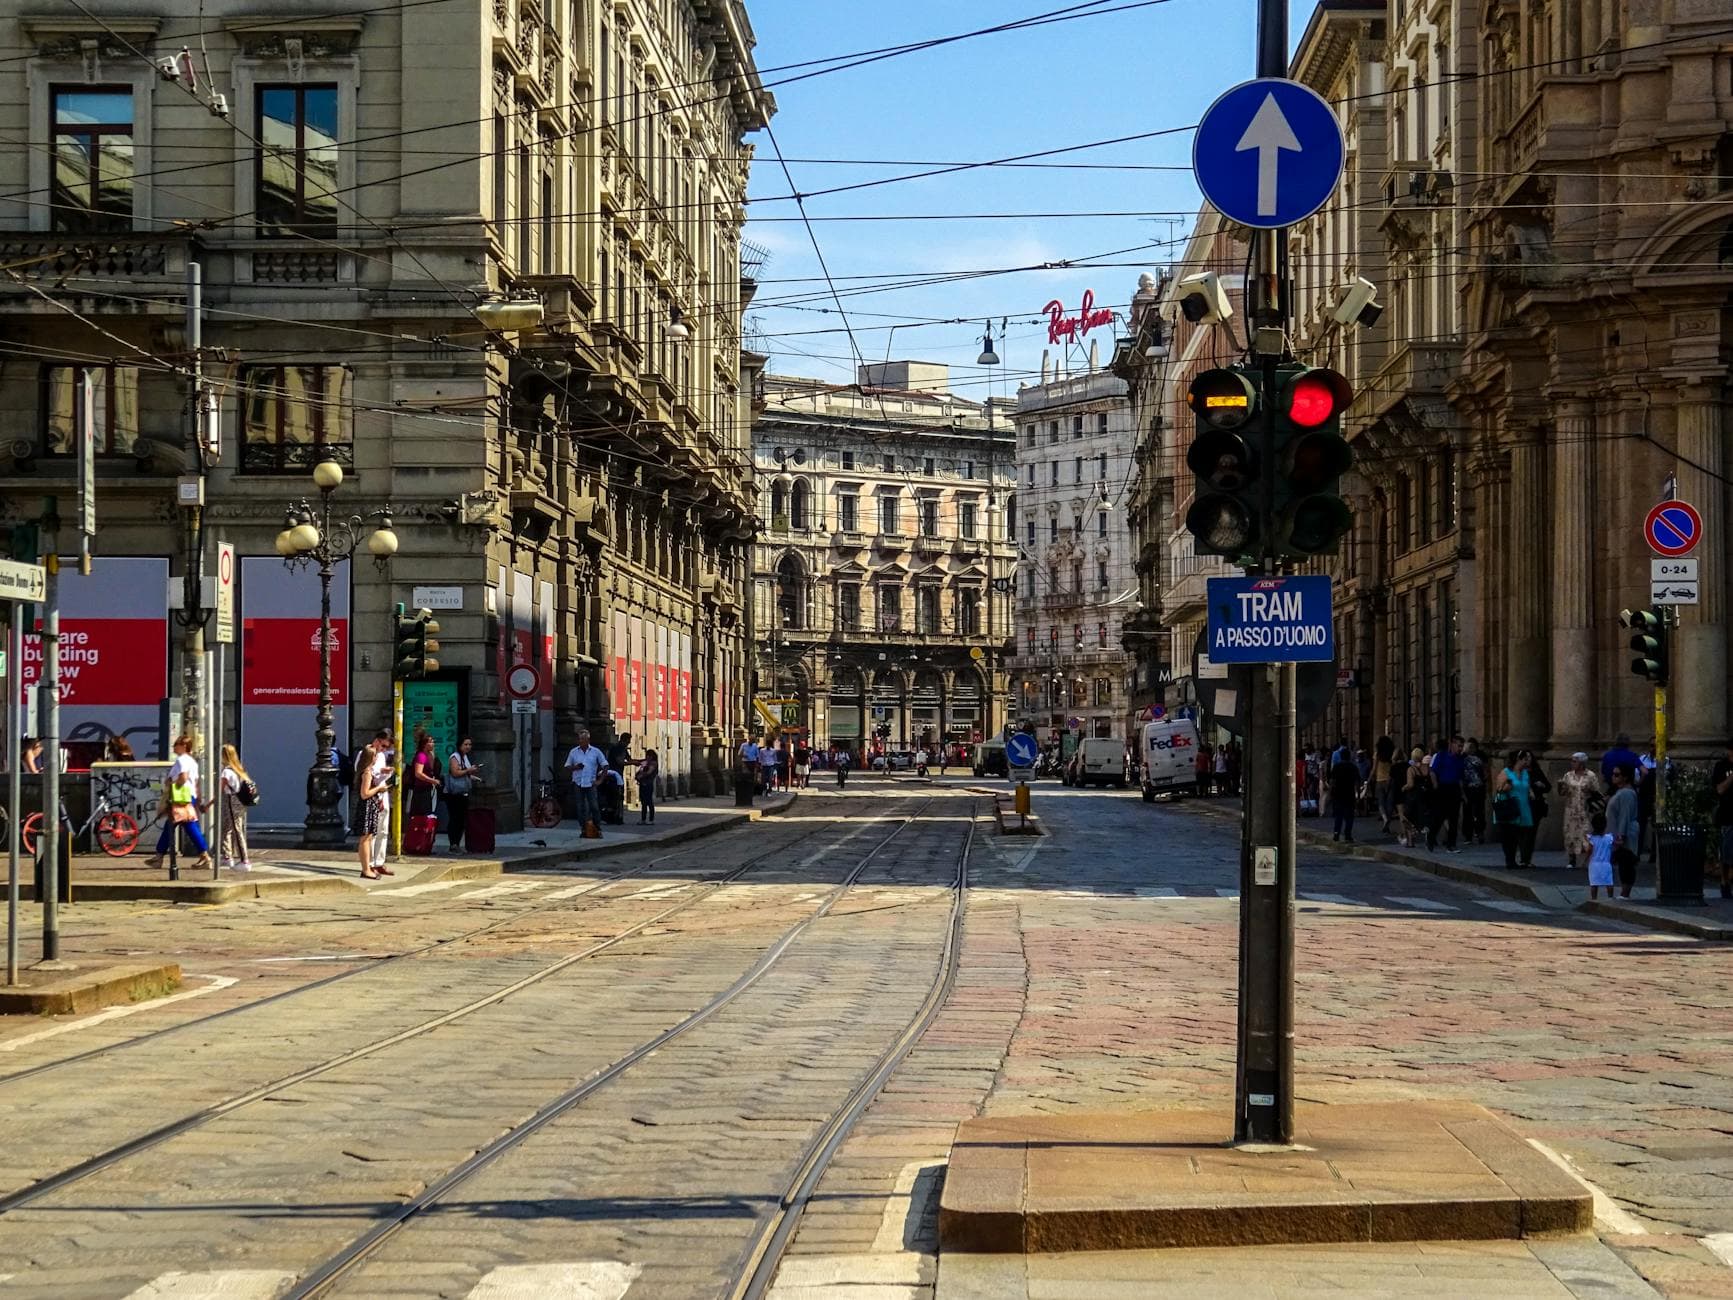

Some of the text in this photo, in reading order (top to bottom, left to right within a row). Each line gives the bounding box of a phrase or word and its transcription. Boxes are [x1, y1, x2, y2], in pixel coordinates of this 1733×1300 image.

[1042, 289, 1113, 345] Ray-Ban
[1661, 566, 1688, 575] 0-24
[1237, 591, 1303, 622] TRAM
[58, 632, 89, 644] are
[1215, 625, 1326, 648] A PASSO D'UOMO
[24, 646, 99, 665] buding
[23, 666, 35, 678] a
[1150, 735, 1192, 751] FedEx
